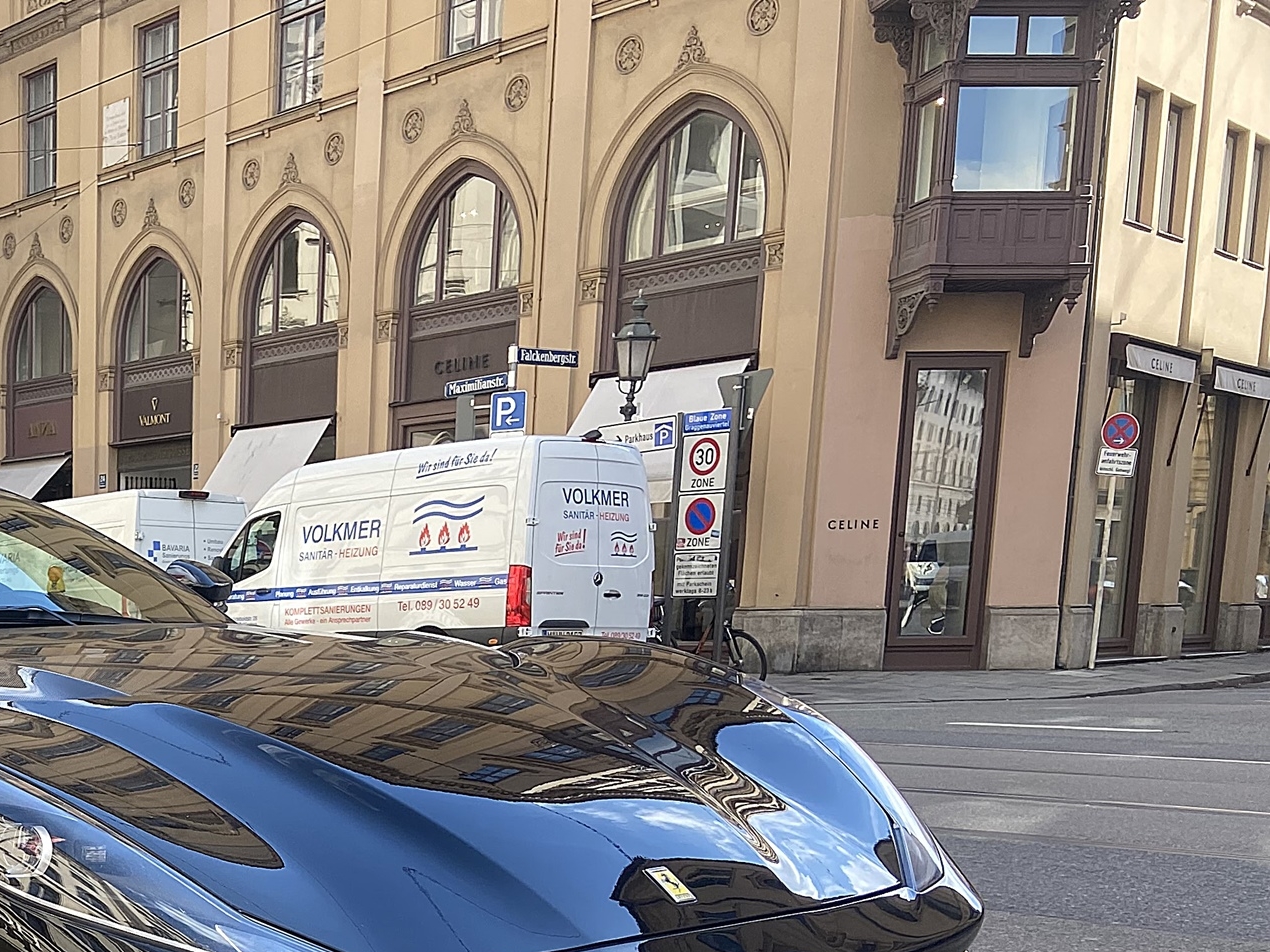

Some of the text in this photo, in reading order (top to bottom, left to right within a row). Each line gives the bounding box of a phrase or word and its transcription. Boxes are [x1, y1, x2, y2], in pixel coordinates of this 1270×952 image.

[434, 353, 491, 375] CELINE
[520, 349, 577, 366] Falckenbergstr.
[1151, 358, 1173, 374] CELINE
[448, 376, 504, 396] Maximilianstr.
[1237, 378, 1256, 393] CELINE
[139, 412, 171, 426] VALMONT
[495, 397, 516, 427] P
[710, 412, 727, 421] Zone
[624, 433, 654, 444] Parkhaus
[418, 461, 433, 474] Wir
[433, 456, 451, 471] sind
[464, 452, 478, 465] Sie
[479, 448, 498, 463] da!
[695, 448, 714, 466] 30
[691, 477, 715, 489] ZONE
[562, 487, 629, 507] VOLKMER
[563, 509, 594, 520] SANITÄR
[599, 512, 629, 522] HEIZUNG
[303, 519, 381, 544] VOLKMER
[827, 519, 879, 530] CELINE
[557, 531, 568, 542] Wir
[687, 537, 710, 547] ZONE
[162, 544, 190, 552] BAVARIA
[299, 548, 333, 562] SANITÄR
[338, 545, 378, 559] HEIZUNG
[275, 591, 294, 599] Planung
[308, 588, 337, 596] Ausführung
[394, 582, 438, 591] Reparaturdienst
[454, 579, 477, 587] Wasser
[285, 605, 371, 616] KOMPLETTSANIERUNGEN
[398, 601, 413, 611] Tel.
[453, 598, 465, 609] 52
[467, 597, 480, 608] 49
[329, 615, 371, 624] Ansprechpartner
